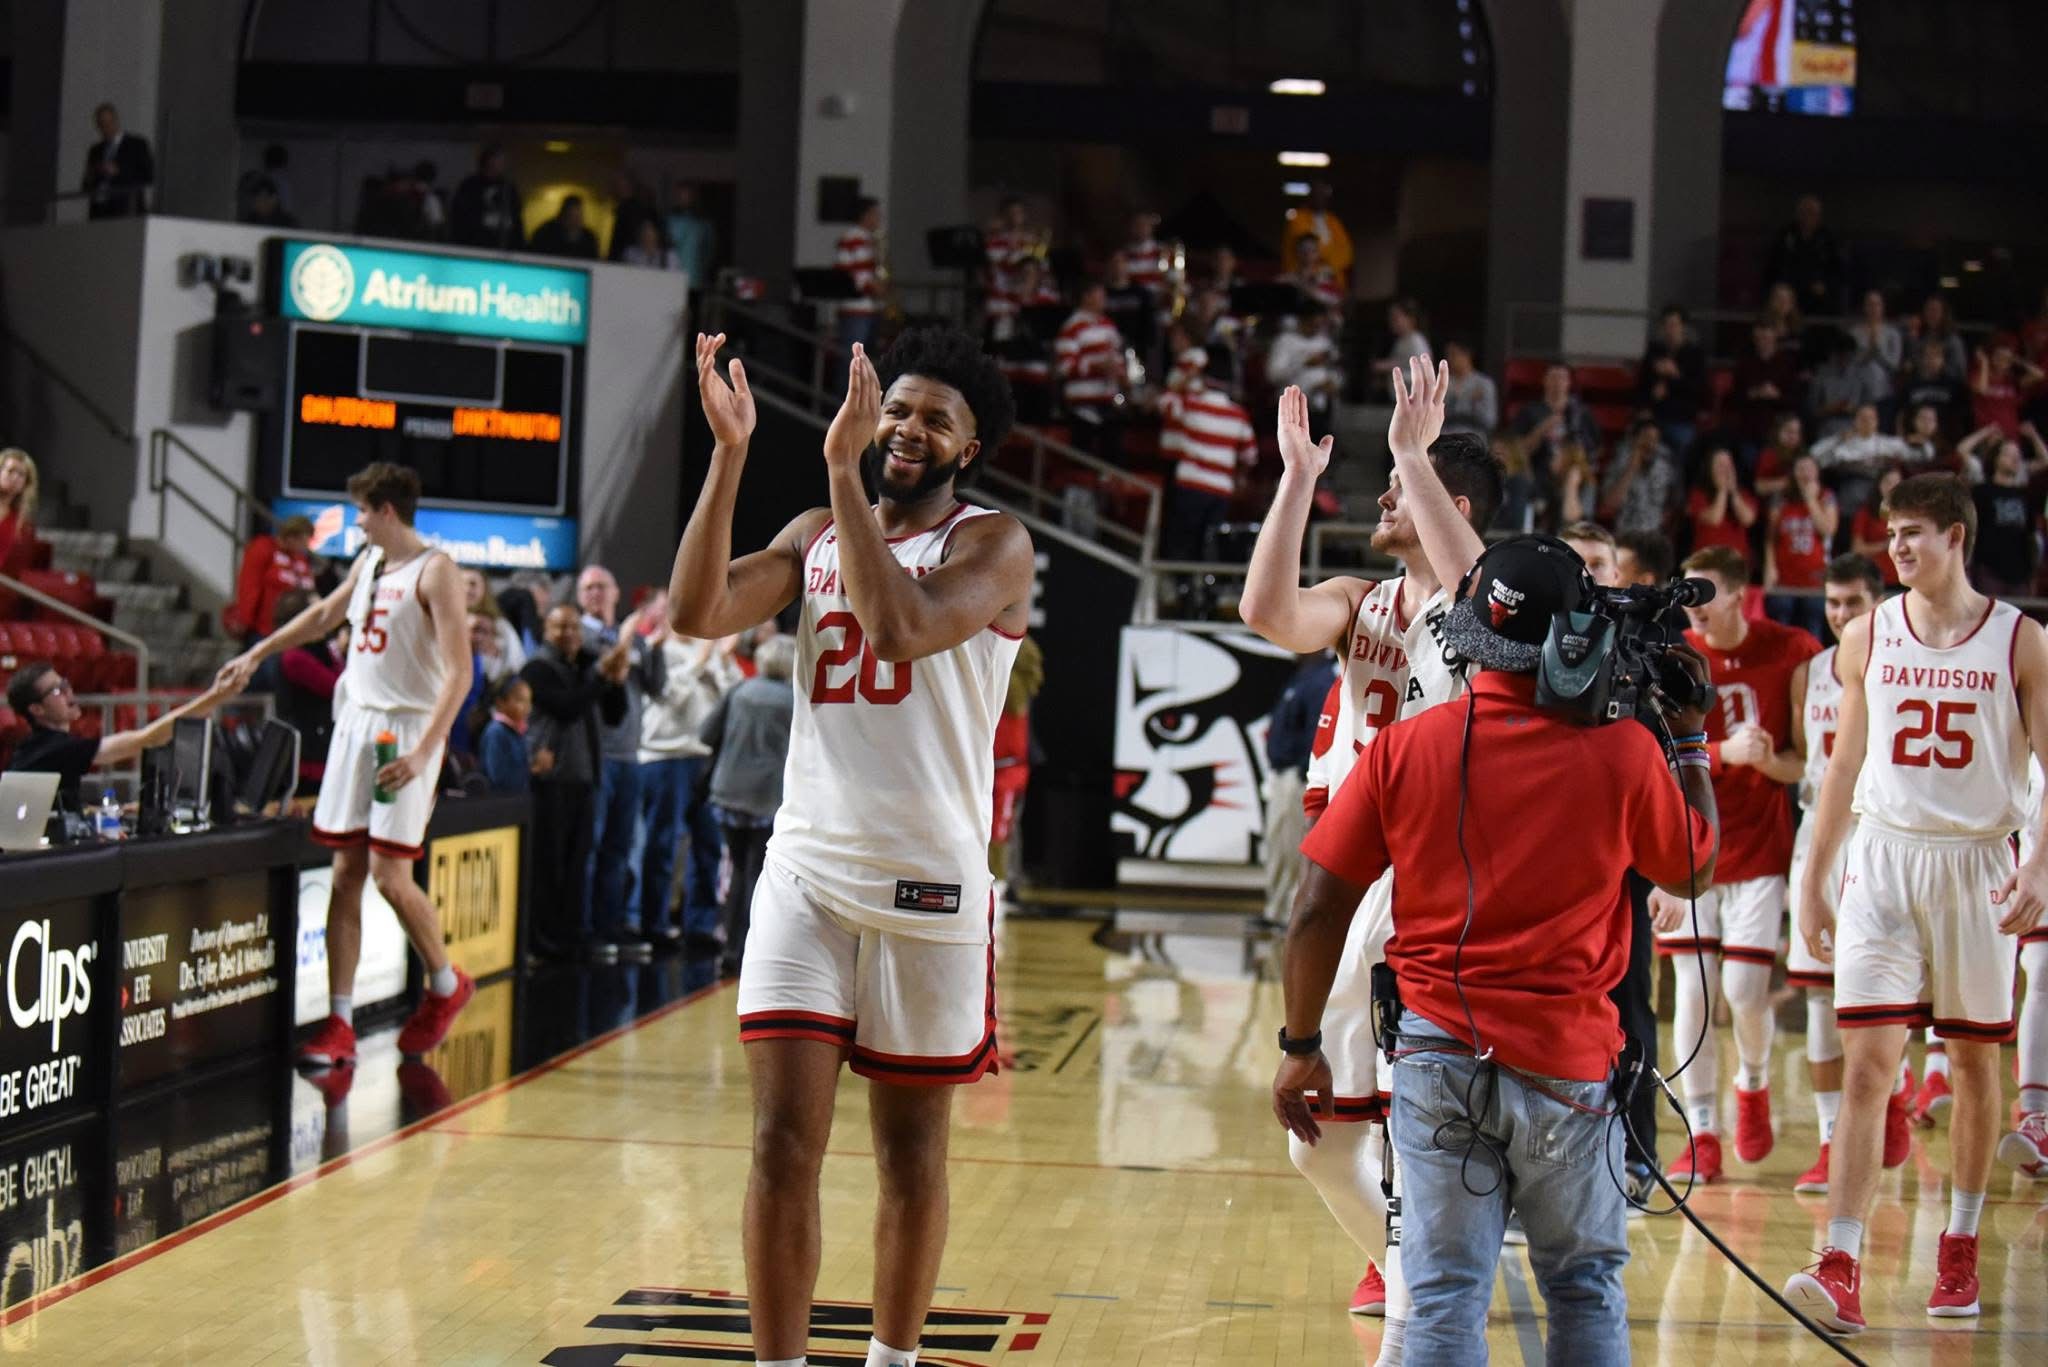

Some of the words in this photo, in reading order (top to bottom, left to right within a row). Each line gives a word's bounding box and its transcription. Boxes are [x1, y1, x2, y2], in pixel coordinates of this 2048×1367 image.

[361, 268, 477, 316] Atrium
[480, 279, 581, 327] Health
[1492, 578, 1525, 601] CHICAGO
[1493, 589, 1517, 606] BULLS
[810, 611, 912, 705] 20
[1882, 664, 1998, 693] DAVIDSON
[1891, 699, 1977, 769] 25
[123, 933, 168, 970] NIVERSITY
[7, 919, 92, 1052] Clips
[134, 974, 151, 1005] EYE
[0, 1069, 22, 1118] BE
[25, 1055, 78, 1110] GREAT
